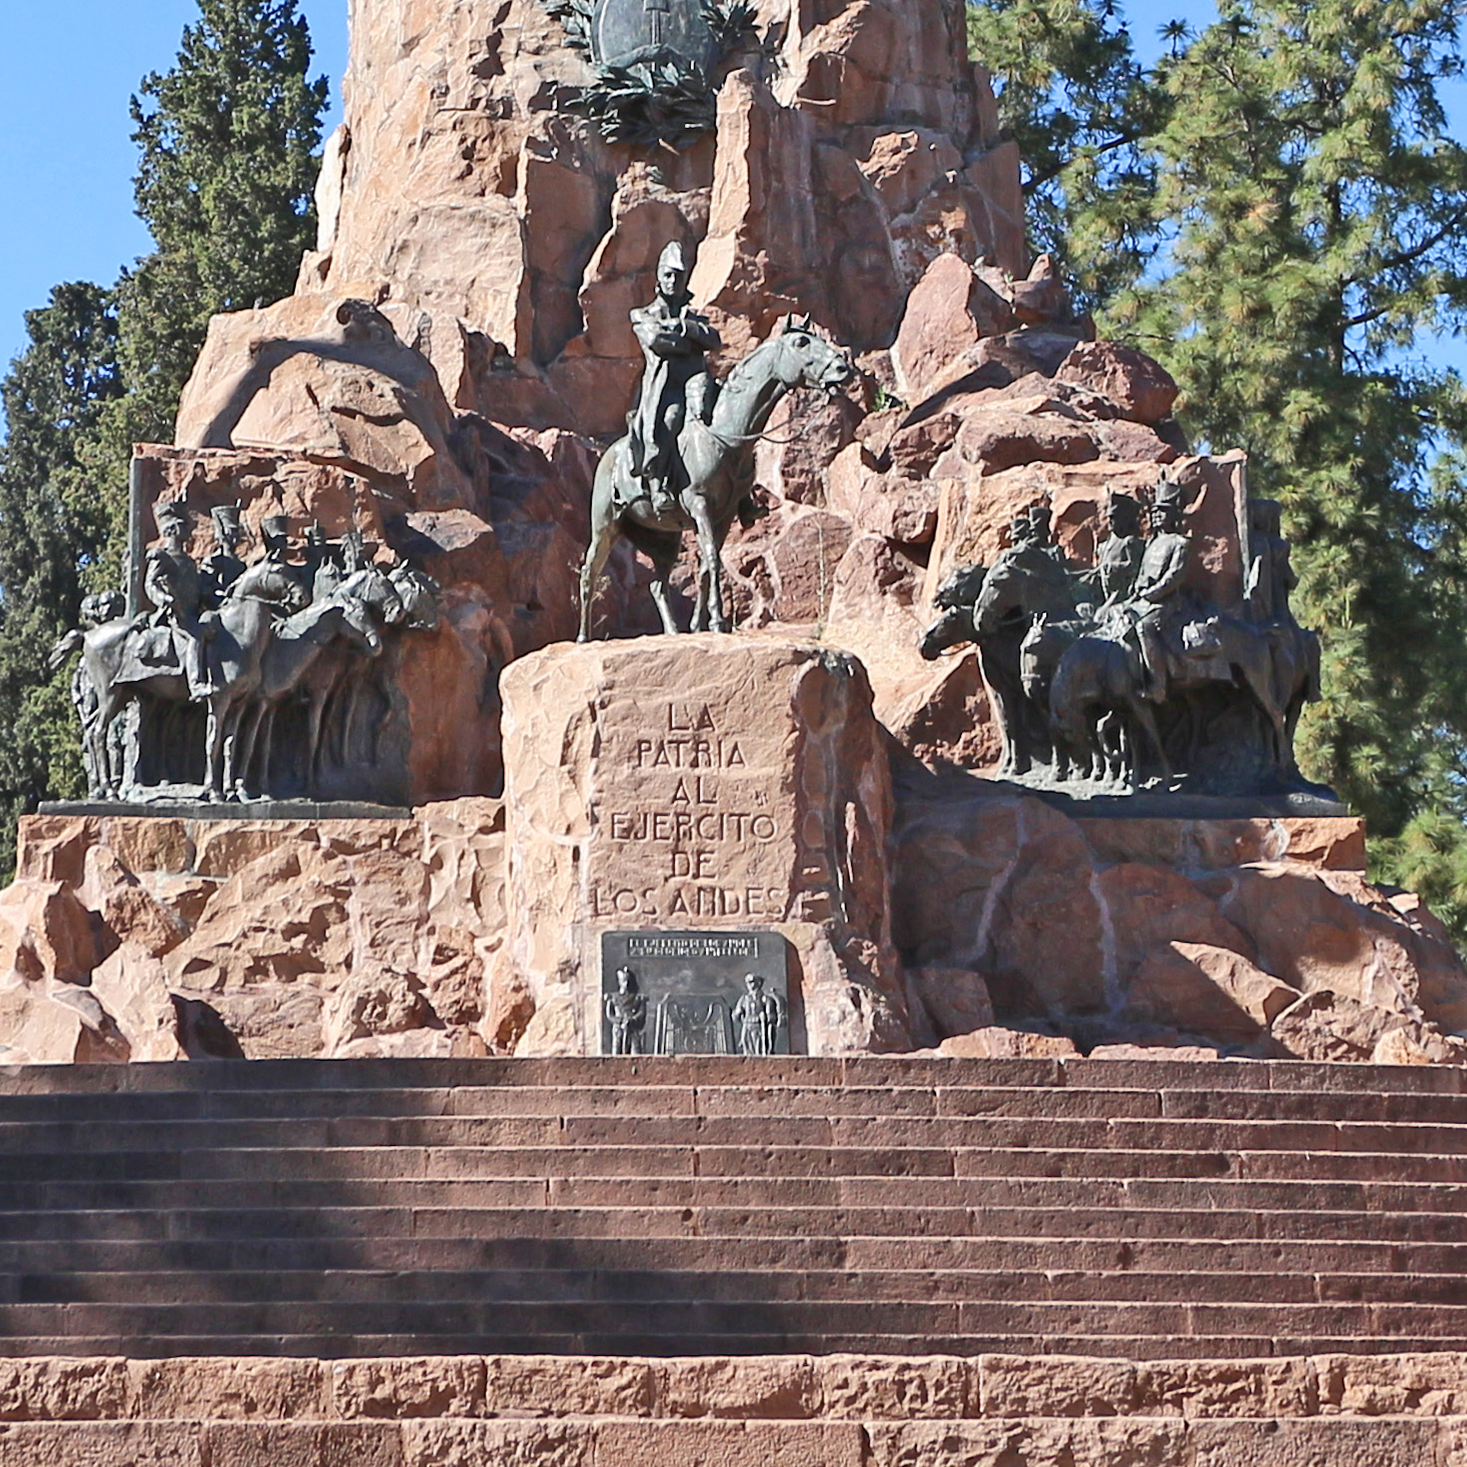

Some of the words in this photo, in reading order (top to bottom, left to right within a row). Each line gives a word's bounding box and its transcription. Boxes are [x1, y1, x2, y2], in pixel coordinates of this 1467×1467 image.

[668, 702, 717, 732] LA
[637, 739, 747, 768] PATRIA
[671, 776, 718, 805] AL
[610, 812, 777, 842] EJERCITO
[671, 850, 718, 880] DE
[594, 887, 660, 917] LOS
[670, 886, 786, 917] ANDES
